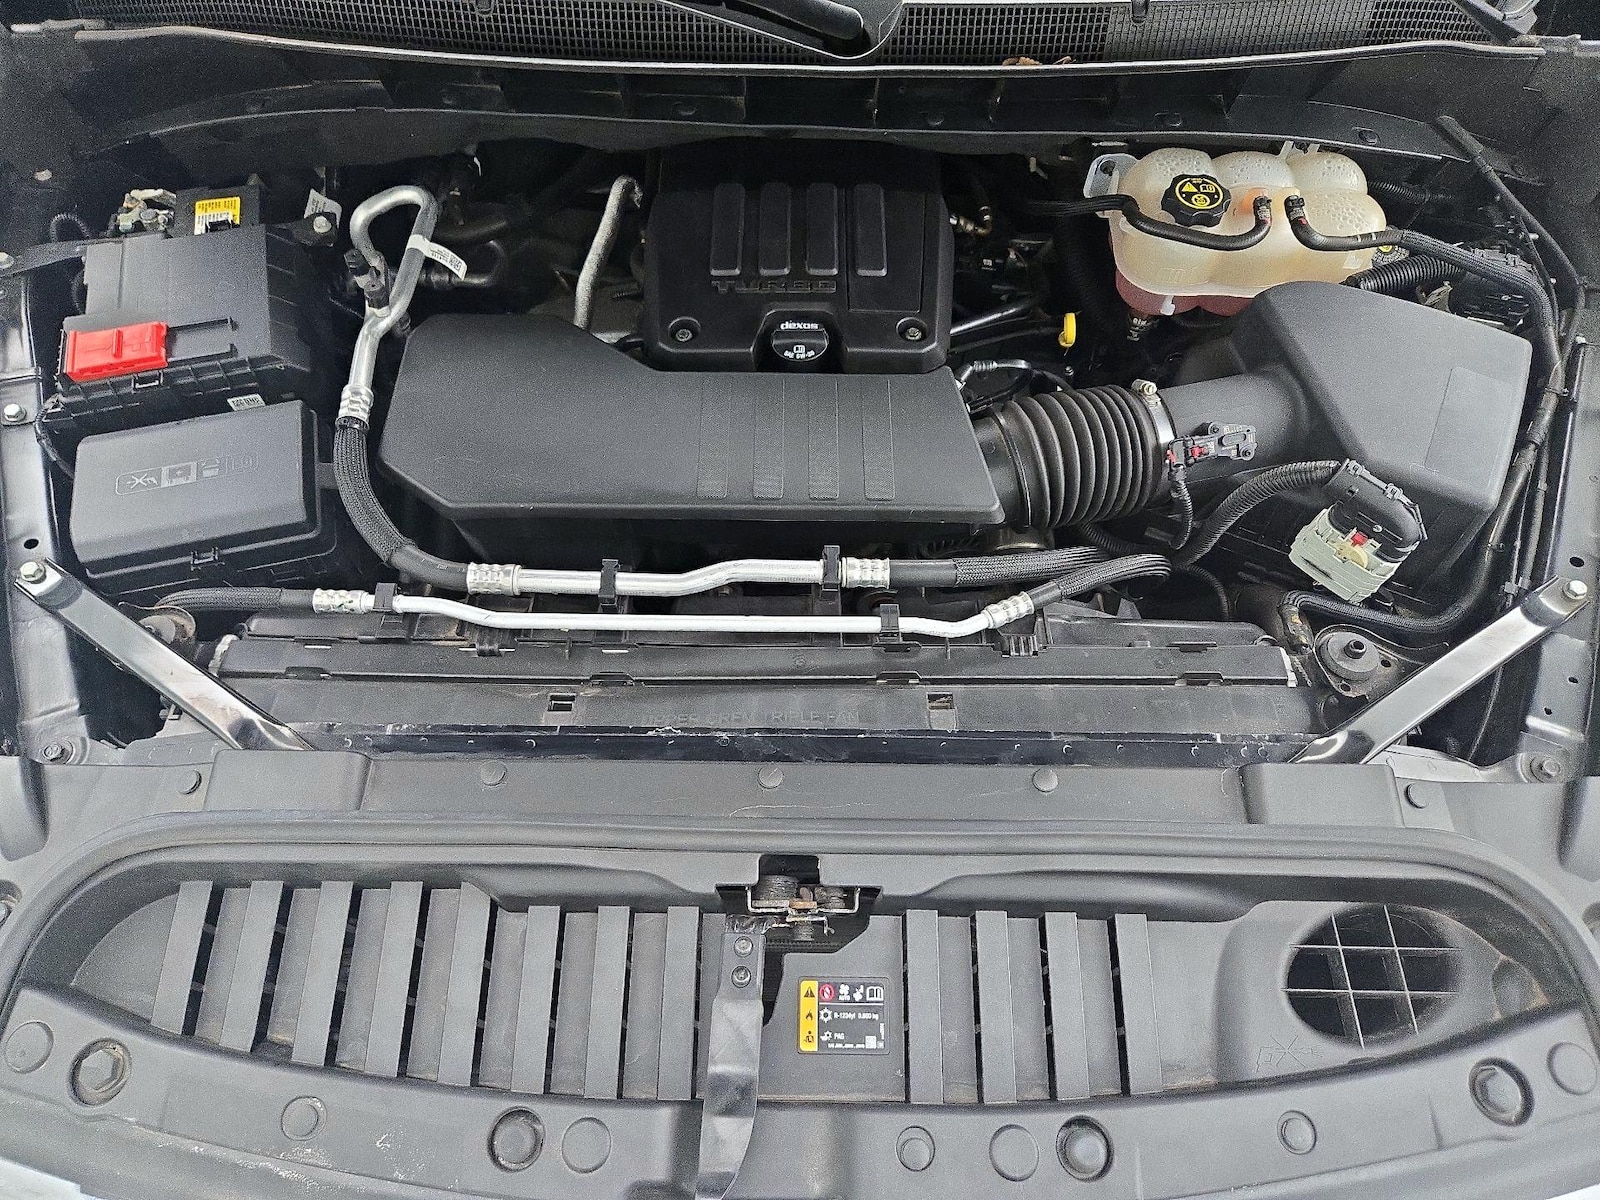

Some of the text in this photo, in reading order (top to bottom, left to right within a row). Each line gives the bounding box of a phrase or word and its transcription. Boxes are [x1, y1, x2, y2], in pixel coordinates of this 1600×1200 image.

[780, 320, 819, 330] dexos
[827, 710, 860, 723] FAN
[833, 1032, 845, 1040] PAG
